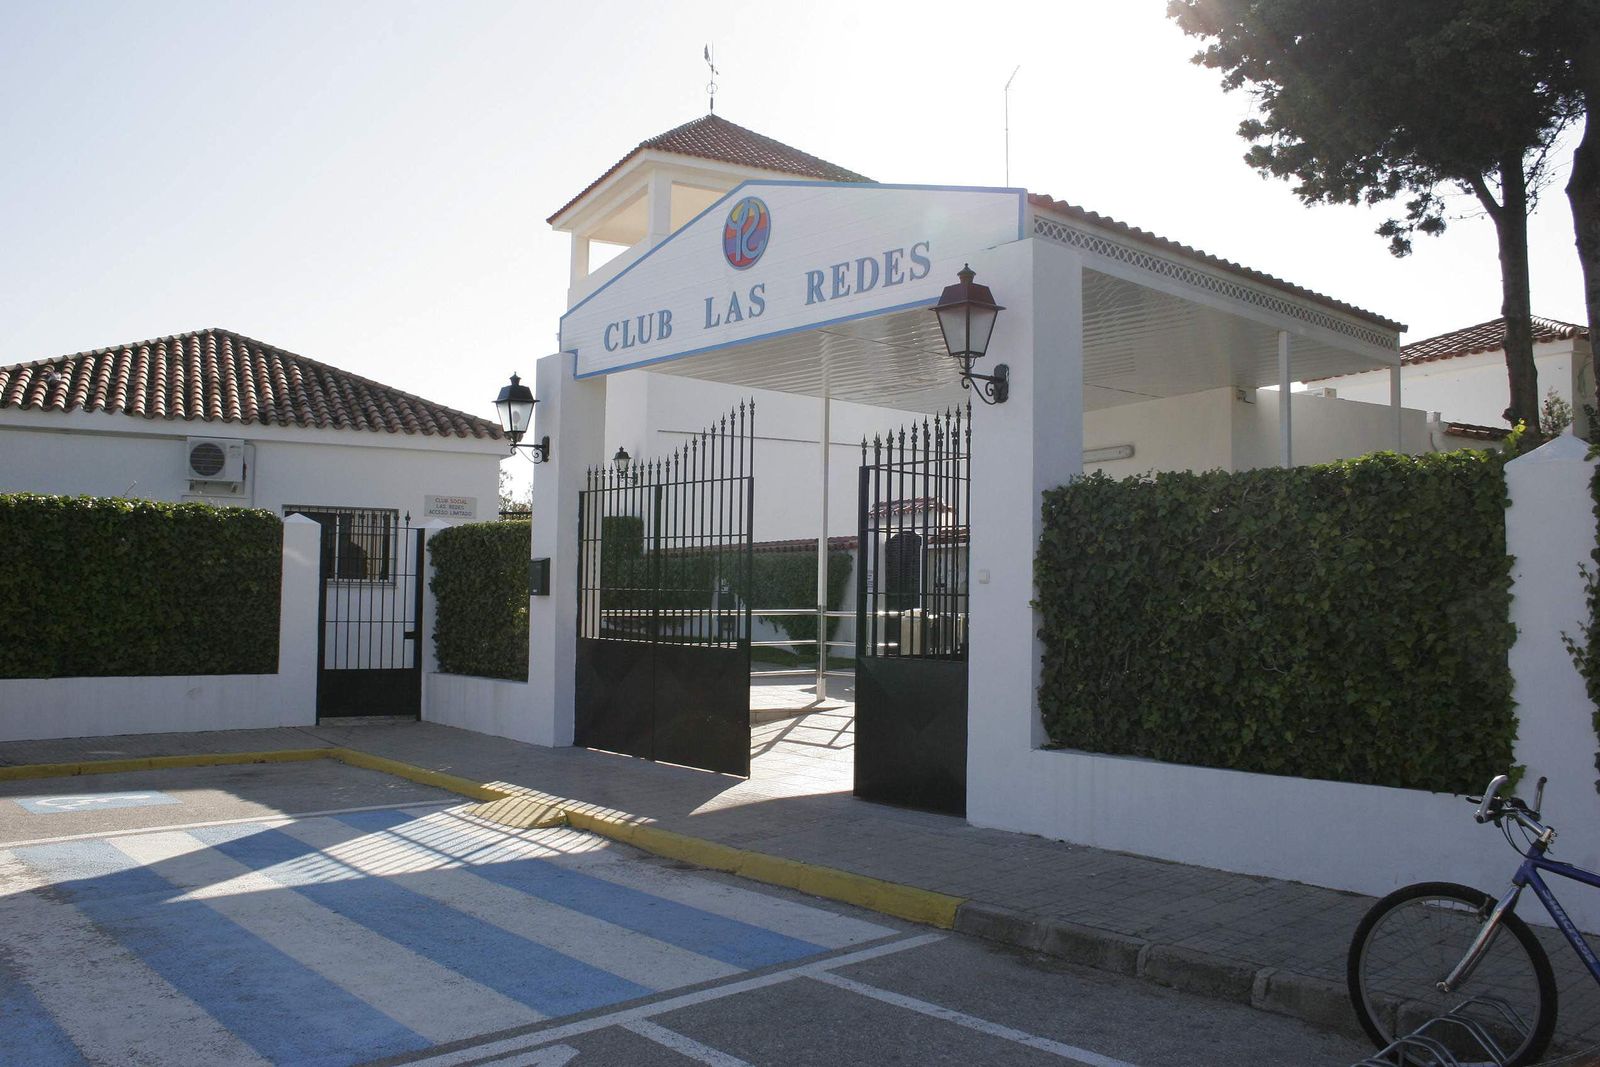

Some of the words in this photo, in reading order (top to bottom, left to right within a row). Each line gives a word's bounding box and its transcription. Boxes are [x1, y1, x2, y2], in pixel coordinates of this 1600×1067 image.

[603, 308, 673, 352] CLUB
[703, 283, 766, 330] LAS
[804, 240, 931, 306] REDES
